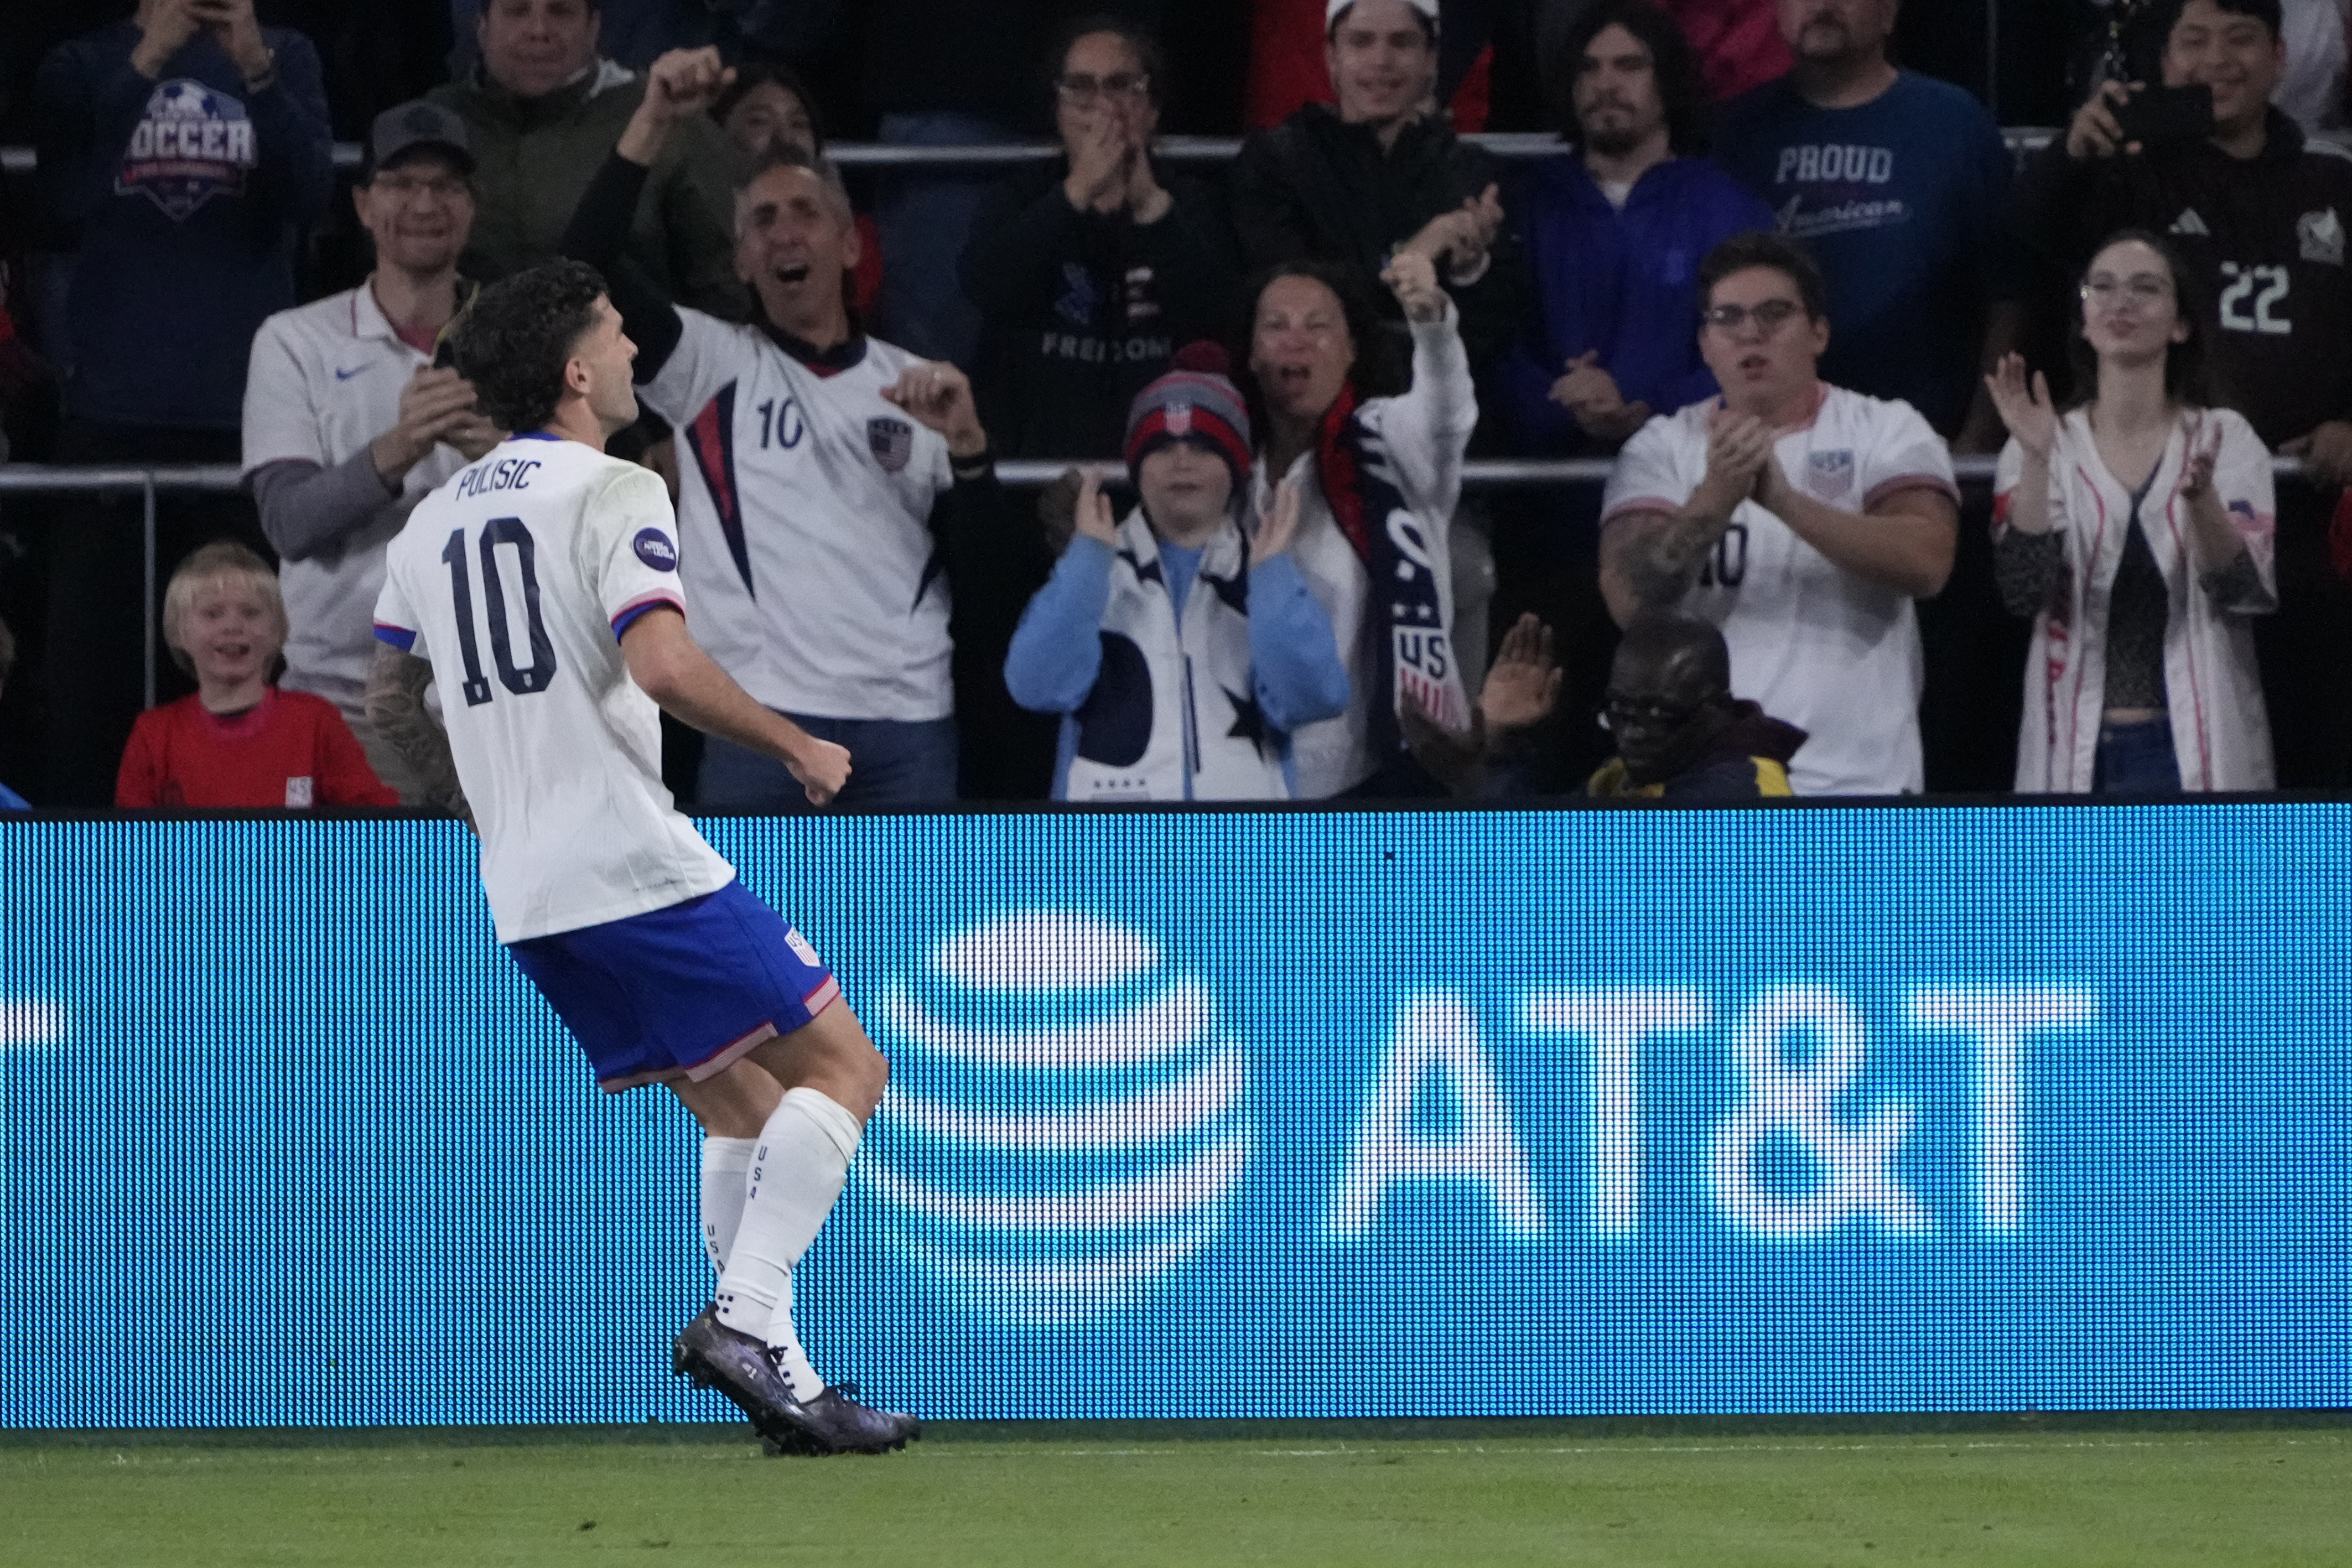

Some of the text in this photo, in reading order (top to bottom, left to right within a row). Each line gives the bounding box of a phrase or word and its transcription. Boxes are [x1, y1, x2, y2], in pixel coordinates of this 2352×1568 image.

[131, 120, 253, 163] OCCER
[1774, 144, 1892, 184] PROUD
[1777, 194, 1903, 236] American
[2219, 260, 2292, 334] 22
[757, 397, 803, 449] 10
[455, 458, 541, 501] PULISIC
[442, 517, 557, 708] 10
[1400, 632, 1446, 679] US
[1329, 983, 2098, 1238] AT&T
